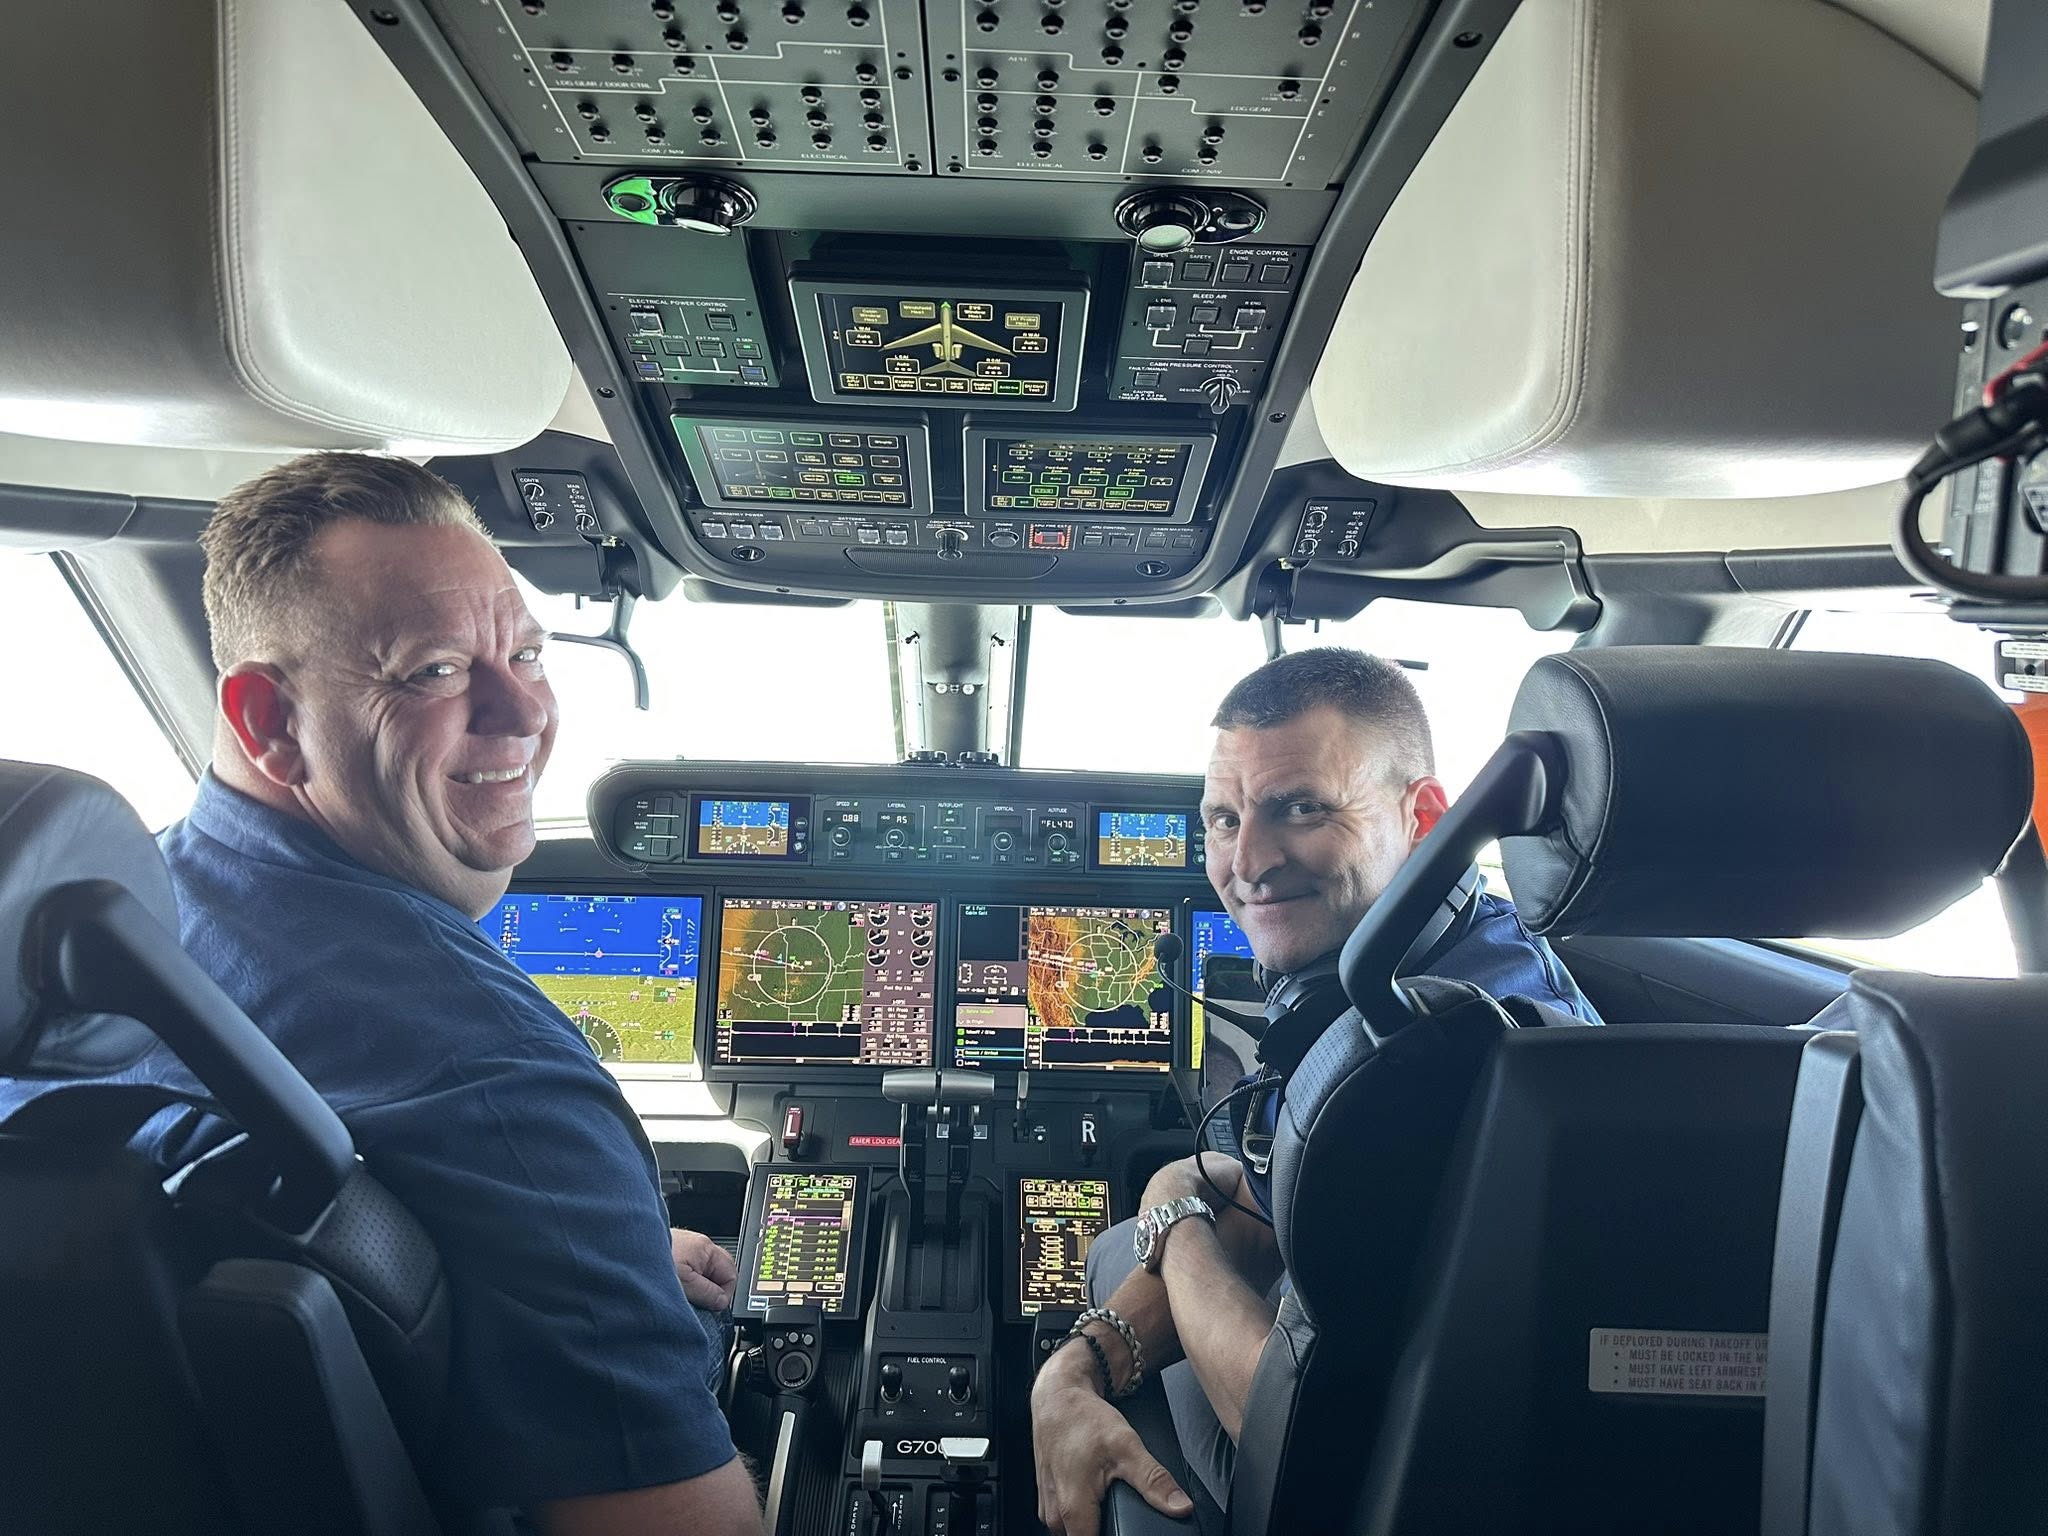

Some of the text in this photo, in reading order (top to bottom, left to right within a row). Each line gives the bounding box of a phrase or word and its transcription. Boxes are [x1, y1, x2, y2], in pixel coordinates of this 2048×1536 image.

[1046, 820, 1074, 829] FL470
[785, 1114, 797, 1137] L
[1082, 1120, 1097, 1143] R
[852, 1137, 870, 1145] EMER
[1600, 1335, 1608, 1346] IF
[1612, 1336, 1663, 1347] DEPLOYED
[1667, 1336, 1705, 1348] DURING
[1708, 1338, 1751, 1349] TAKEOFF
[1629, 1350, 1657, 1361] MUST
[1660, 1351, 1674, 1362] BE
[1677, 1352, 1716, 1363] LOCKED
[1719, 1352, 1730, 1363] IN
[1734, 1353, 1752, 1363] THE
[1628, 1363, 1762, 1377] MUST HAVE LEFT ARMREST
[1628, 1378, 1758, 1391] MUST HAVE SEAT BACK IN
